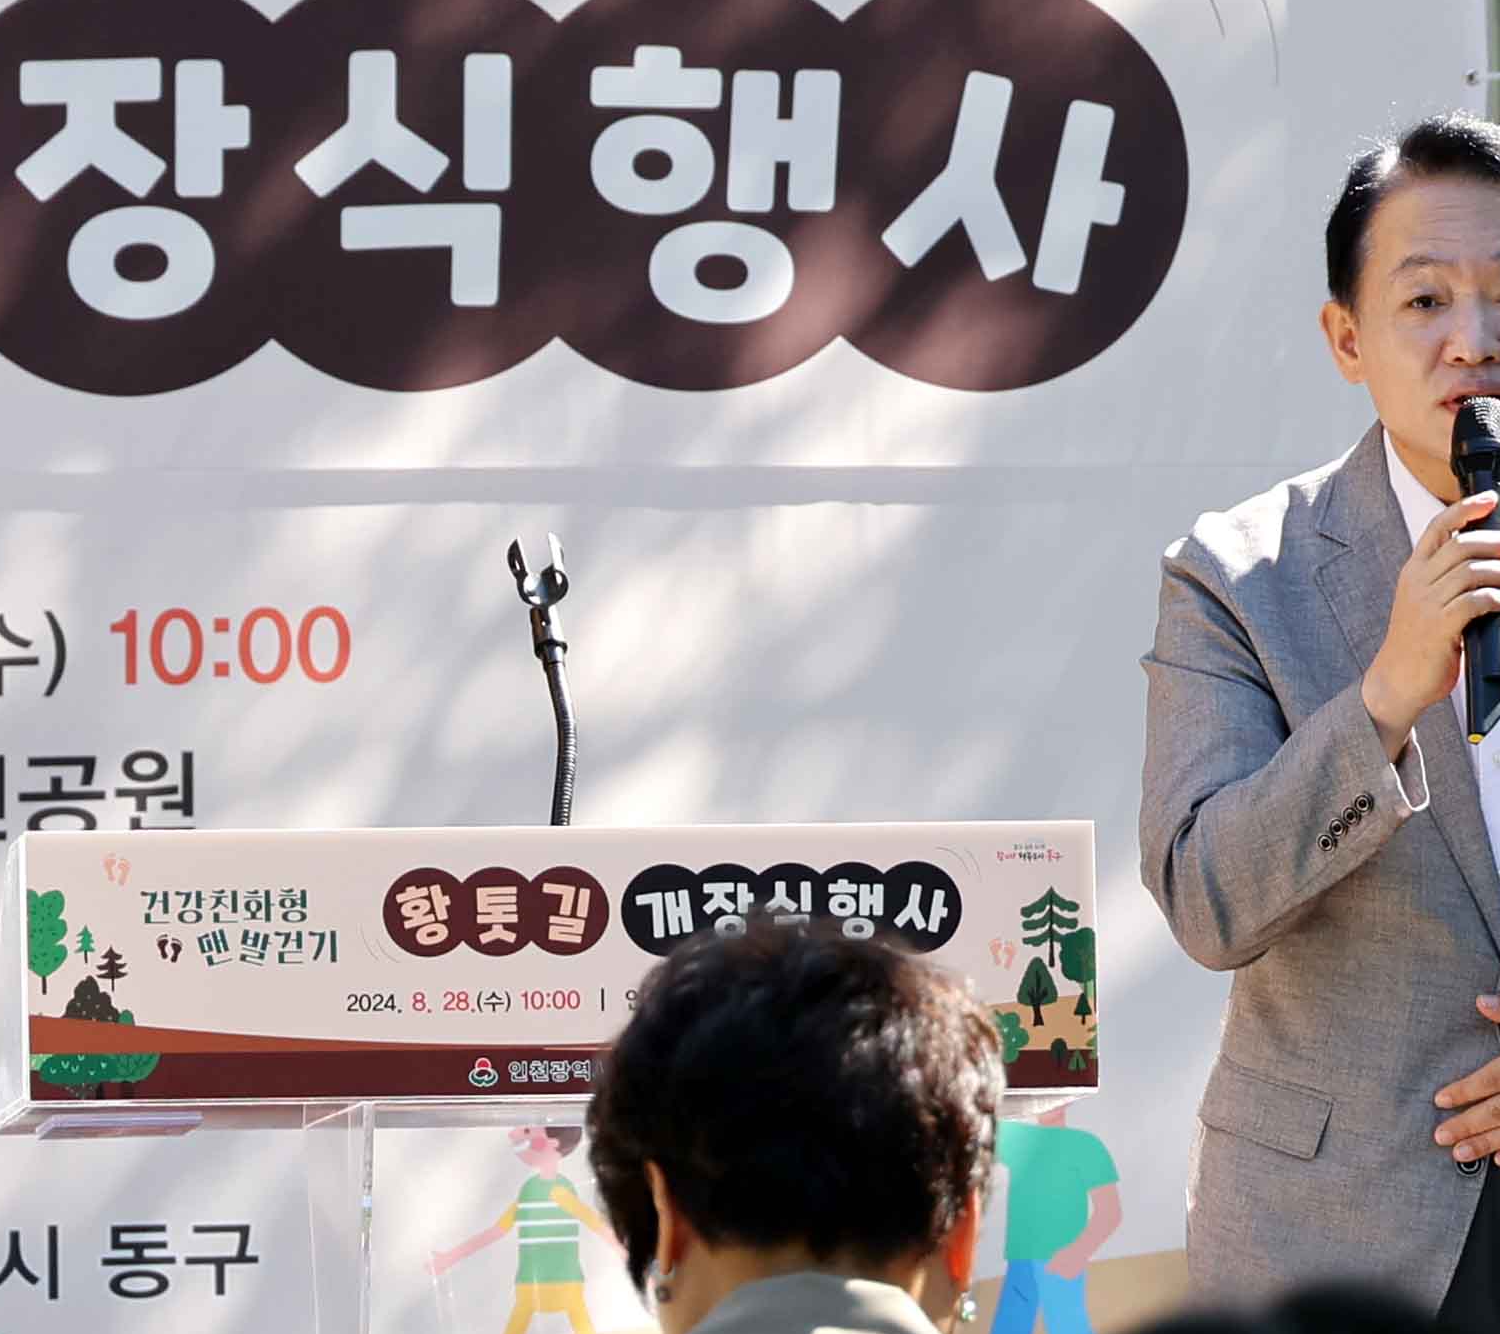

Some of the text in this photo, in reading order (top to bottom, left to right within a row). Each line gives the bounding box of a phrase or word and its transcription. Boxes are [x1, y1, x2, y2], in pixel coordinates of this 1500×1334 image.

[110, 605, 353, 687] 10:00
[140, 887, 309, 924] 건강친화형
[395, 882, 591, 945] 황톳길
[347, 993, 403, 1014] 2024.
[410, 990, 433, 1014] 8.
[519, 987, 582, 1011] 10:00
[508, 1059, 605, 1083] 인천광역
[101, 1224, 260, 1300] 동구
